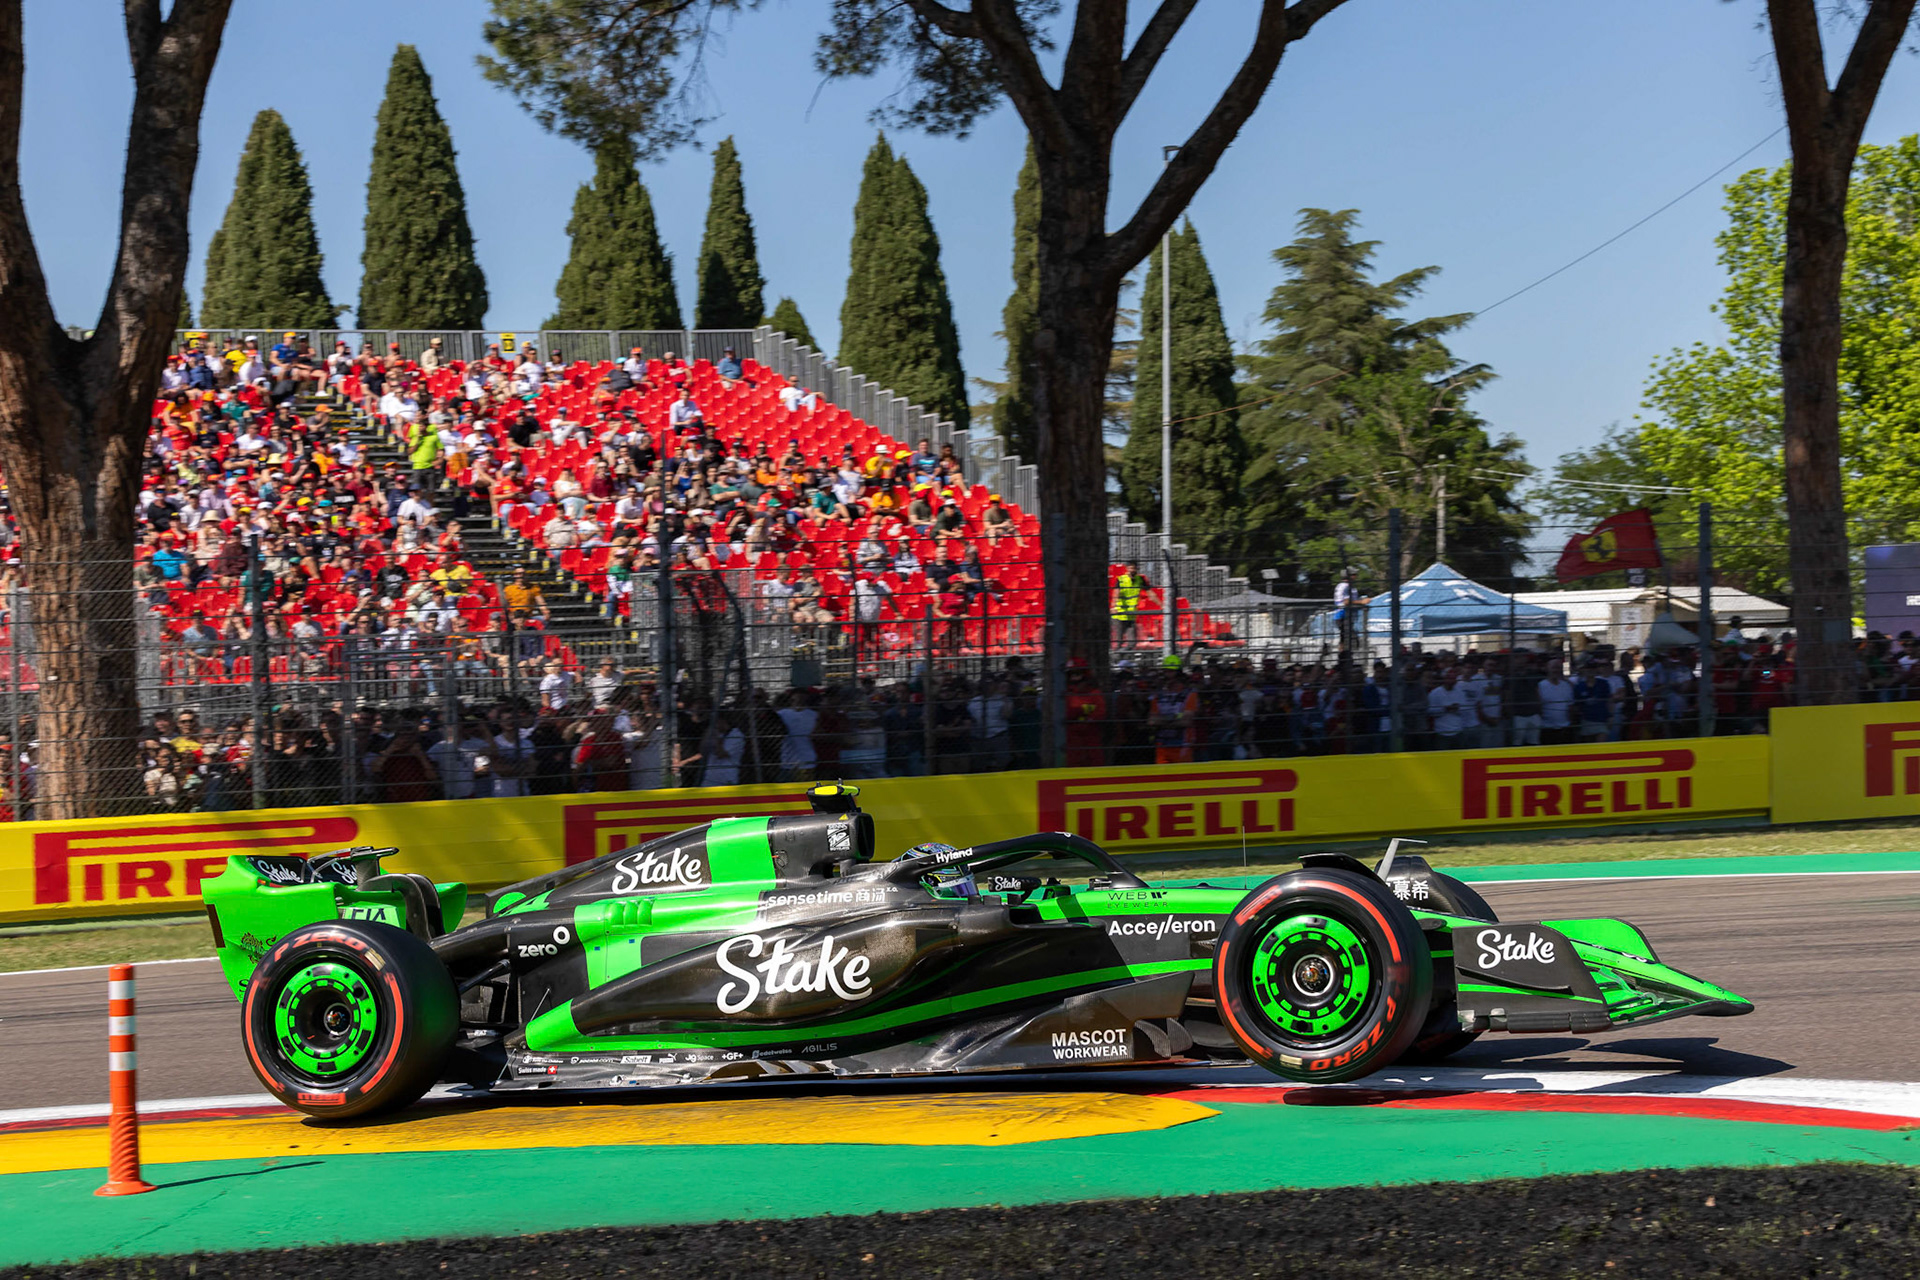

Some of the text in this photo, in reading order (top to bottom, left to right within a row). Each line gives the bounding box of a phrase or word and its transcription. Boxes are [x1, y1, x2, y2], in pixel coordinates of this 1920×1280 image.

[1462, 749, 1696, 820] PIRELLI
[1037, 768, 1298, 841] PIRELLI
[936, 847, 973, 863] Hyland
[257, 859, 304, 884] Stake
[331, 861, 358, 885] Sta
[612, 847, 702, 895] Stake
[994, 876, 1022, 891] Stake
[1386, 879, 1430, 901] 慕希
[767, 890, 853, 906] sensetime
[1107, 901, 1169, 909] EYEWEAR
[1108, 891, 1148, 901] WEB
[292, 930, 371, 952] ZERO
[1476, 929, 1556, 969] Stake
[715, 933, 873, 1015] Stake
[801, 1042, 838, 1054] AGILIS
[1051, 1028, 1127, 1047] MASCOT
[1308, 1021, 1385, 1071] ZERO
[1052, 1045, 1128, 1060] WORKWEAR
